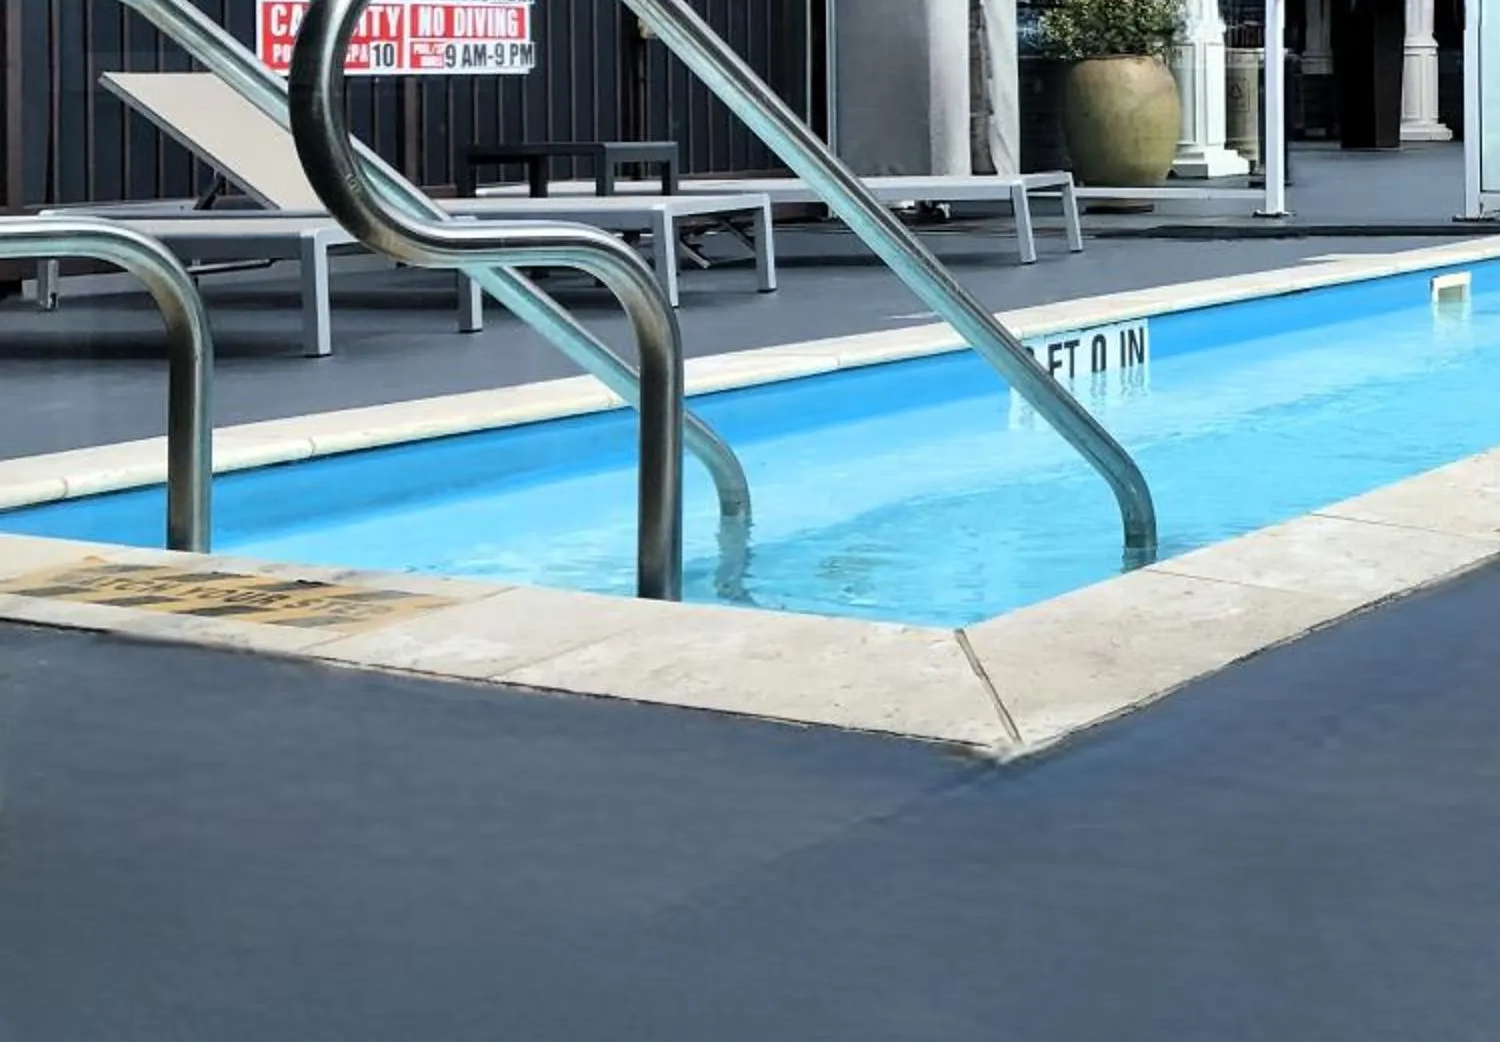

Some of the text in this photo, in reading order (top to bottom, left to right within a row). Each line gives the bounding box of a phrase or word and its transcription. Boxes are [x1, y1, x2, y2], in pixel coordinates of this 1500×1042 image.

[270, 3, 400, 37] CAITY
[419, 6, 519, 38] NO DIVING
[372, 43, 395, 67] 10
[445, 44, 457, 68] 9
[509, 43, 534, 68] PM
[1047, 339, 1081, 379] FT
[1119, 325, 1145, 368] IN
